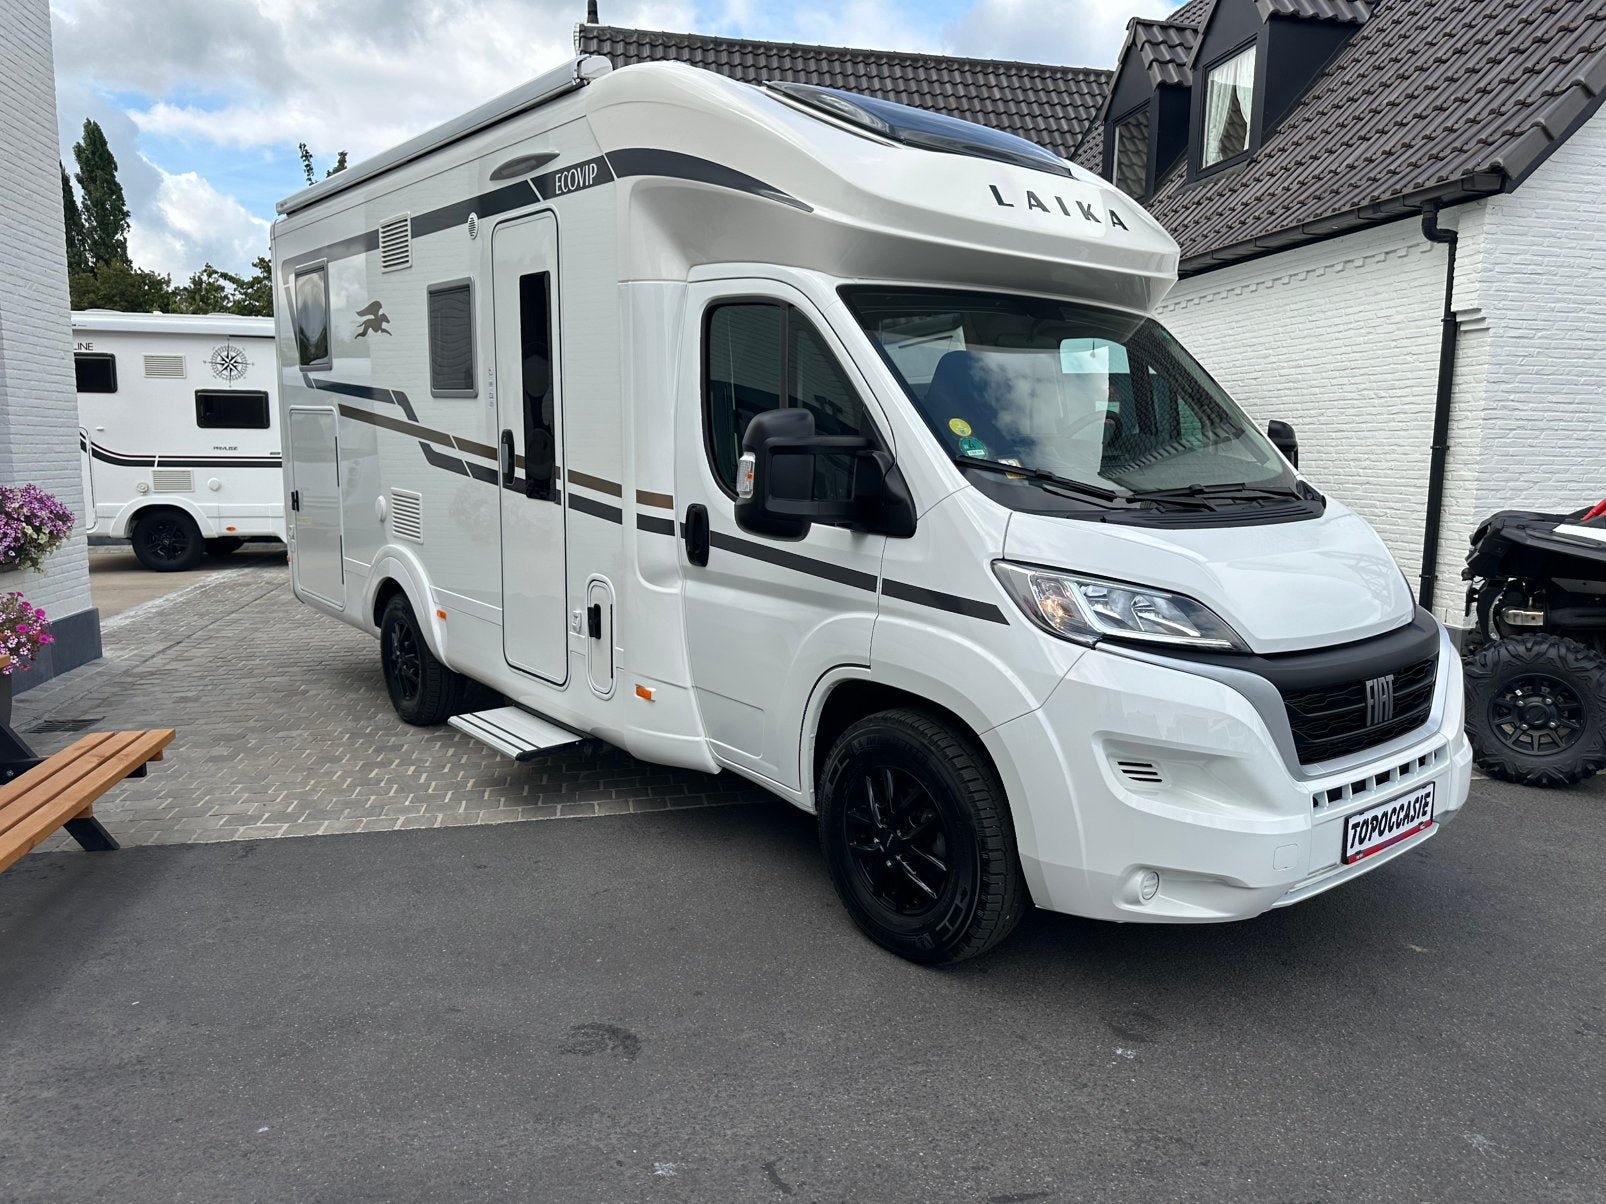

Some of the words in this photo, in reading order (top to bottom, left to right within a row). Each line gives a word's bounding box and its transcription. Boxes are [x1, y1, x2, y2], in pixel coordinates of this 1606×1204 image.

[555, 163, 598, 195] ECOVIP
[988, 184, 1130, 231] LAIKA
[1365, 673, 1395, 728] FIAT
[1349, 790, 1432, 849] TOPOCCASIE
